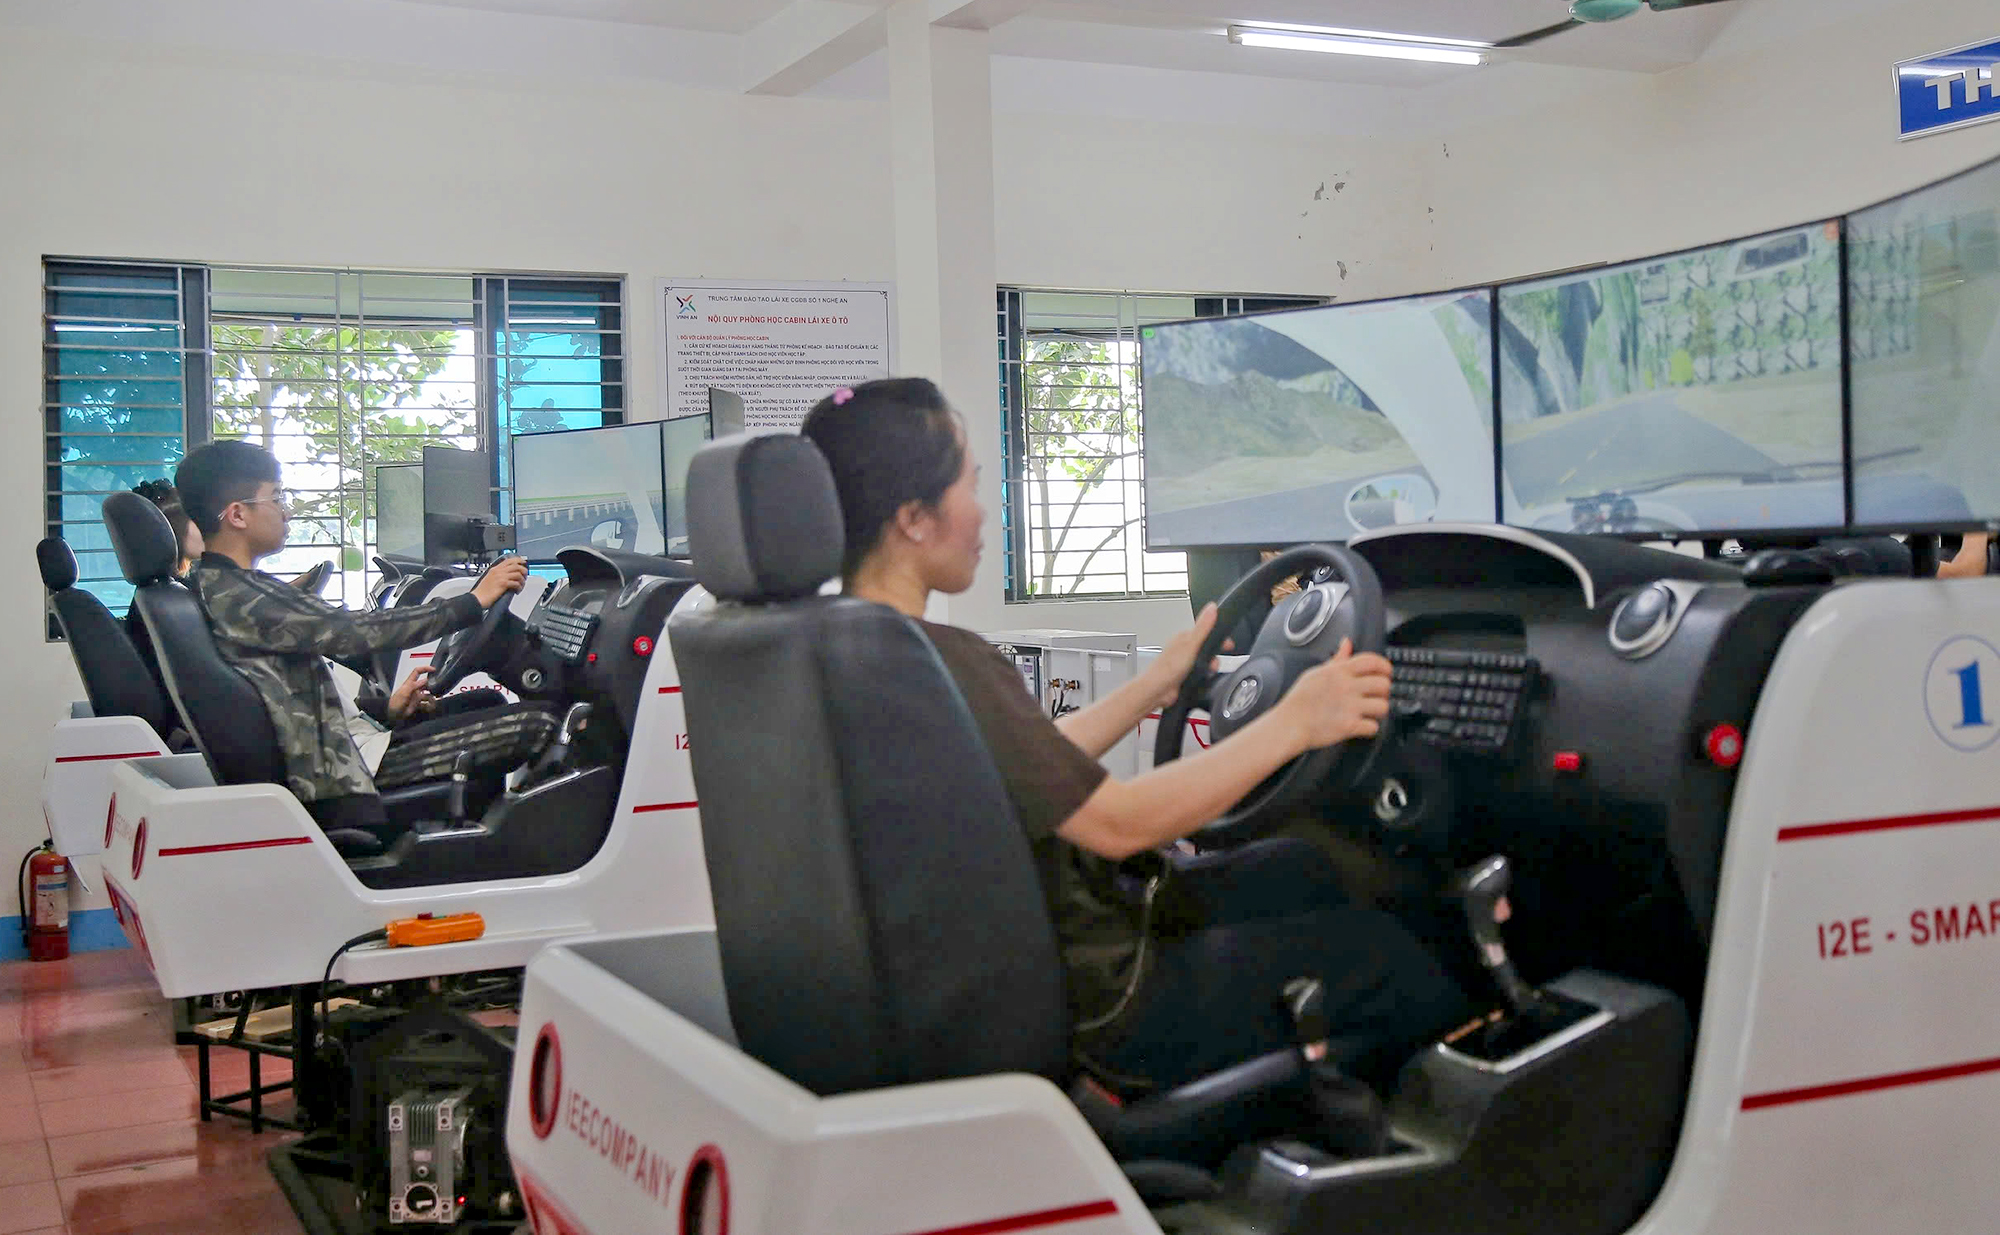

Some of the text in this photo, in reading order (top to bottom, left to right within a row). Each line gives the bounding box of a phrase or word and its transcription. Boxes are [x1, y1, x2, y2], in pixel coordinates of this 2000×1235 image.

[708, 315, 849, 325] NỘI QUY PHÒNG HỌC CABIN LÁI XE Ô TÔ
[1947, 659, 1993, 730] 1
[1817, 916, 1873, 959] I2E
[565, 1088, 677, 1208] IEECOMPANY
